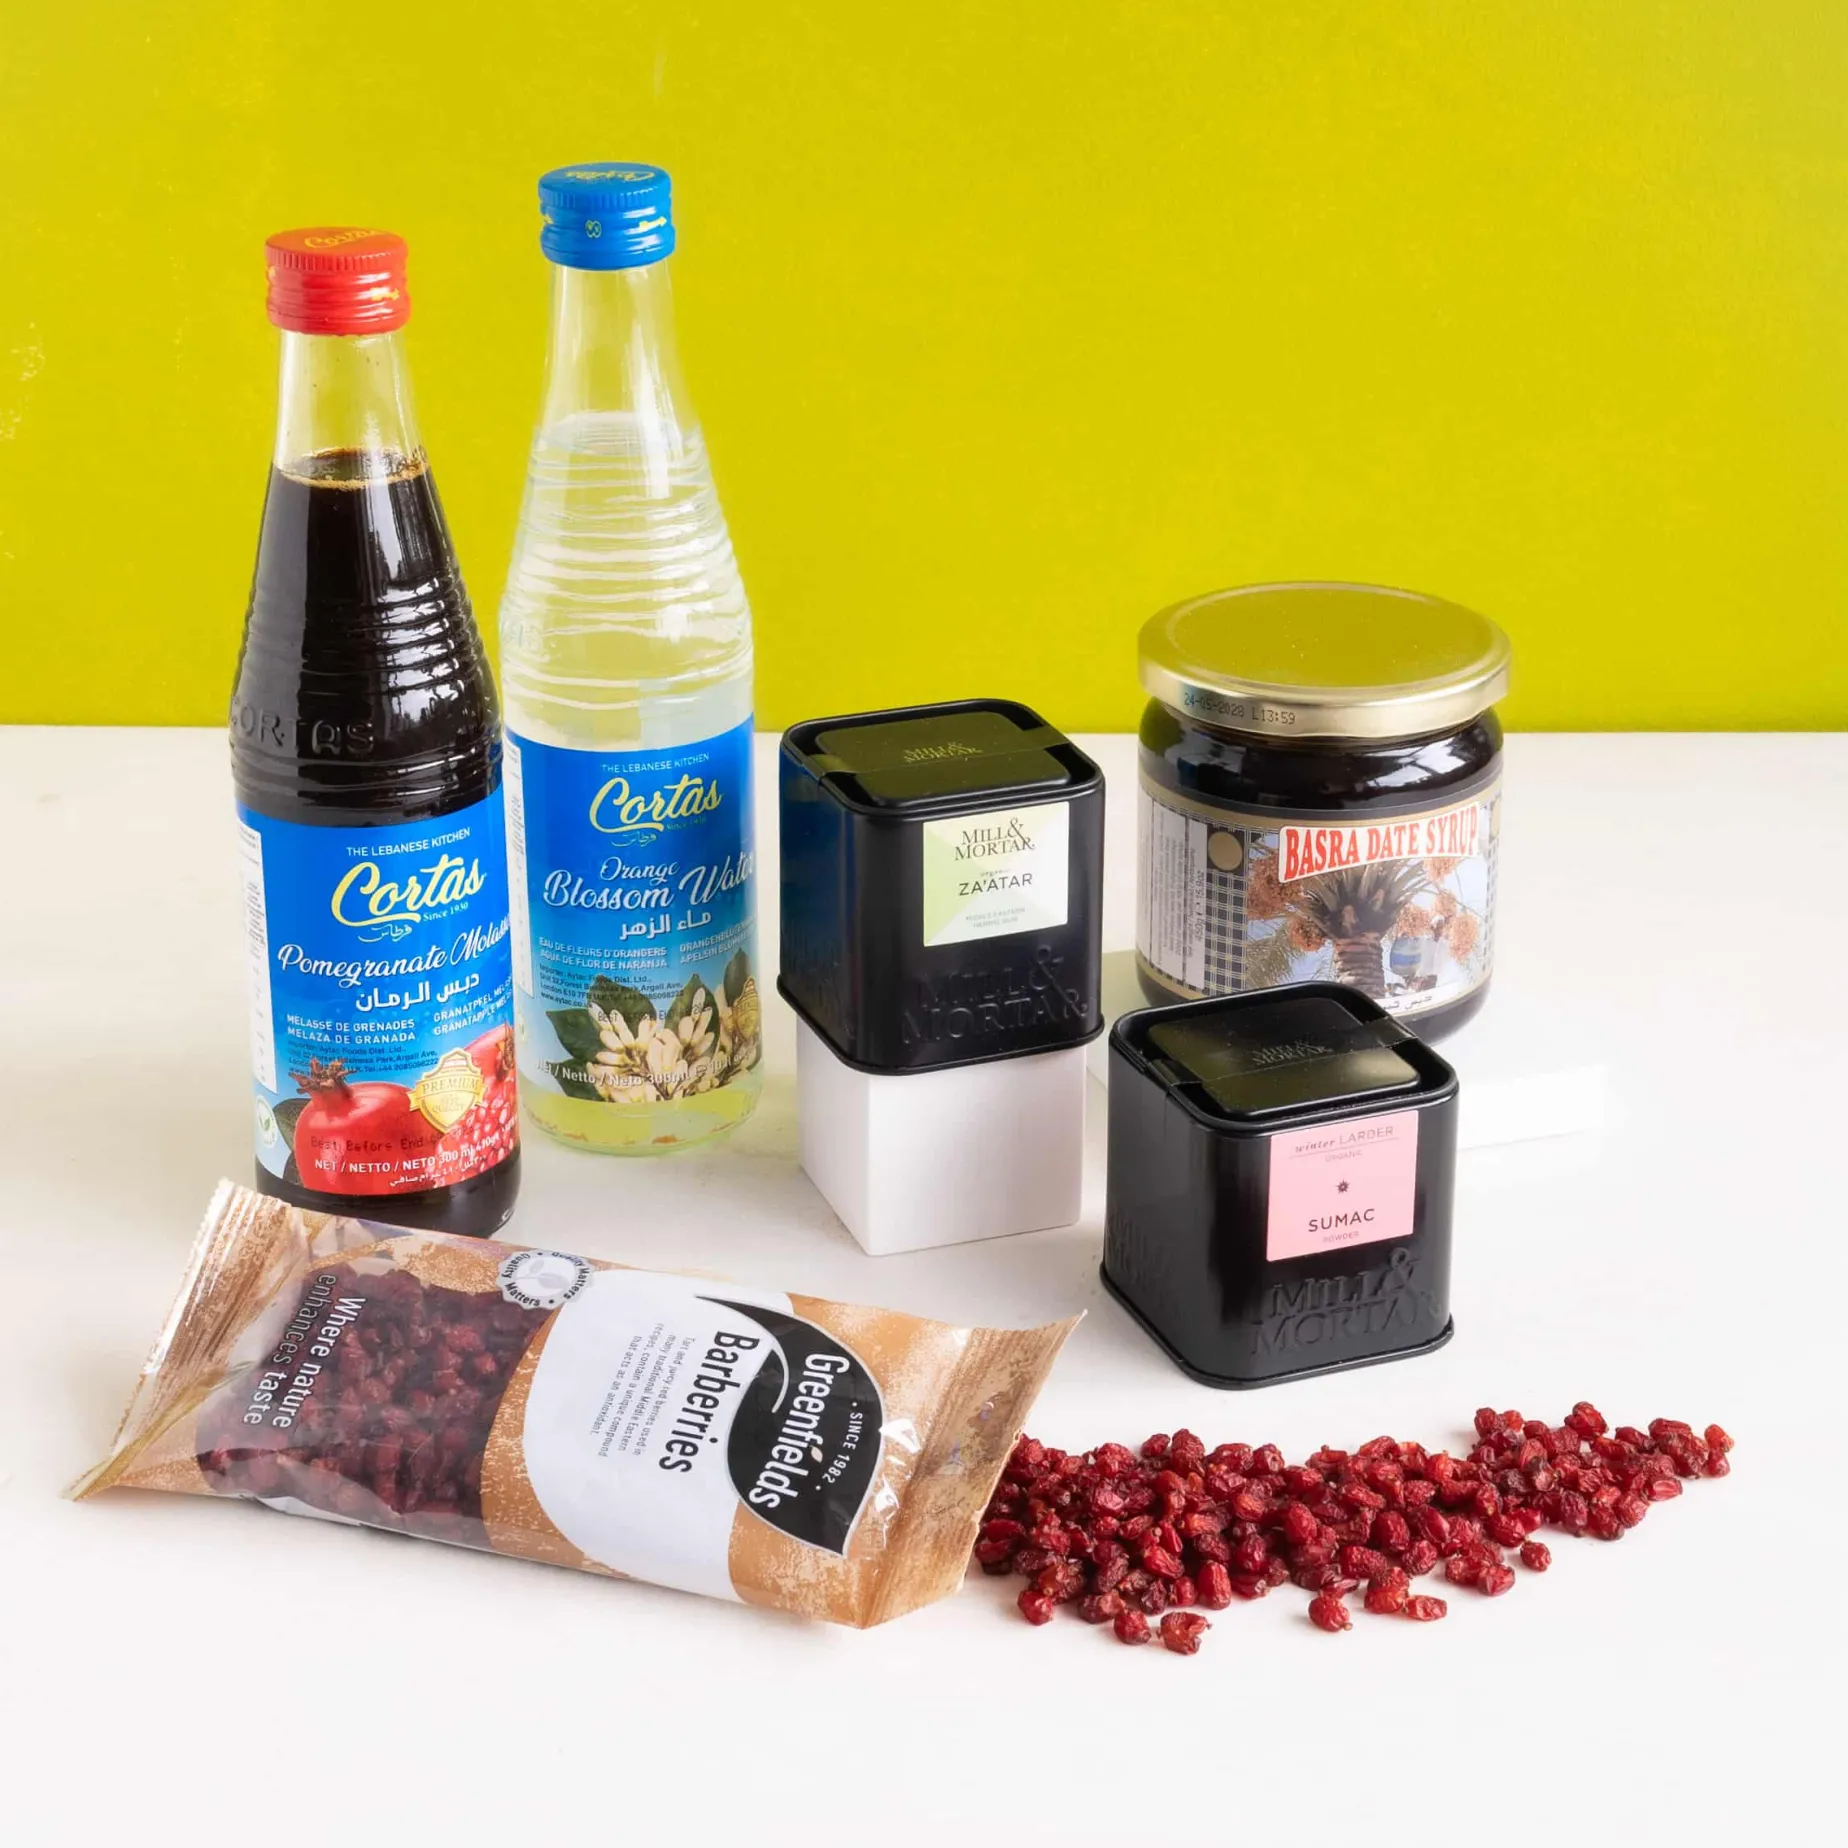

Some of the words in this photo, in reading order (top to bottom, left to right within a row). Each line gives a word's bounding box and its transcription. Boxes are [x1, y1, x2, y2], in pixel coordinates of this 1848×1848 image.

[233, 704, 374, 755] ORTAS
[1252, 707, 1296, 725] L13:59
[602, 763, 620, 774] THE
[623, 759, 673, 774] LEBANESE
[675, 752, 710, 768] KITCHEN
[589, 773, 724, 834] Cortas
[347, 845, 369, 857] THE
[371, 840, 429, 857] LEBANESE
[431, 827, 471, 849] KITCHEN
[961, 816, 1025, 847] MILL&
[1284, 826, 1361, 882] BASRA
[1365, 821, 1421, 861] DATE
[1424, 804, 1479, 858] SYRUP
[954, 834, 1035, 861] MORTAR
[599, 856, 680, 886] Orange
[330, 853, 486, 928] Cortas
[543, 869, 675, 911] Blossom
[958, 873, 1033, 897] ZA'ATAR
[423, 909, 448, 922] Since
[619, 913, 671, 941] الزهر
[676, 908, 712, 931] ماء
[539, 936, 554, 950] EAU
[555, 942, 567, 952] DE
[567, 944, 603, 957] FLEURS
[603, 946, 667, 959] D'ORANGERS
[540, 949, 561, 961] AGUA
[562, 955, 575, 966] DE
[576, 957, 601, 969] FLOR
[602, 960, 617, 970] DE
[618, 959, 668, 970] NARANJA
[277, 944, 448, 989] Pomegranate
[355, 980, 431, 1012] الرمان
[436, 973, 480, 1003] دبس
[287, 1014, 333, 1031] MELASSE
[335, 1022, 351, 1032] DE
[353, 1019, 416, 1032] GRENADES
[287, 1026, 331, 1043] MELAZA
[335, 1034, 351, 1044] DE
[355, 1032, 416, 1045] GRANADA
[422, 1077, 478, 1095] PREMIUM
[562, 1066, 597, 1085] Netto
[608, 1075, 642, 1087] Neto
[310, 1136, 338, 1150] Best
[345, 1139, 393, 1152] Before
[400, 1138, 425, 1151] End
[1295, 1140, 1336, 1153] winter
[1338, 1126, 1394, 1144] LARDER
[315, 1159, 337, 1172] NET
[349, 1162, 391, 1173] NETTO
[402, 1157, 436, 1172] NETO
[438, 1150, 459, 1164] 300
[1308, 1208, 1375, 1233] SUMAC
[501, 1252, 531, 1279] Quality
[504, 1281, 542, 1307] Matters
[563, 1267, 591, 1301] Matters
[1269, 1247, 1420, 1318] MILL&
[273, 1274, 338, 1365] enhances
[310, 1297, 367, 1358] Where
[1248, 1290, 1446, 1356] MORTAR
[628, 1335, 643, 1351] that
[660, 1334, 677, 1354] many
[681, 1337, 695, 1350] Tart
[620, 1352, 635, 1368] acts
[632, 1352, 652, 1382] contain
[674, 1351, 687, 1365] and
[610, 1381, 622, 1391] an
[616, 1369, 627, 1380] as
[643, 1355, 668, 1395] traditional
[663, 1366, 678, 1385] juicy
[243, 1371, 288, 1425] taste
[272, 1362, 323, 1429] nature
[616, 1389, 635, 1416] unique
[658, 1331, 761, 1473] Barberries
[659, 1386, 670, 1400] red
[631, 1396, 651, 1421] Middle
[646, 1400, 666, 1426] berries
[598, 1416, 623, 1458] compound
[618, 1422, 639, 1452] Eastern
[636, 1427, 651, 1447] used
[748, 1353, 851, 1509] Greenfields
[842, 1411, 864, 1451] SINCE
[822, 1453, 851, 1485] 1982
